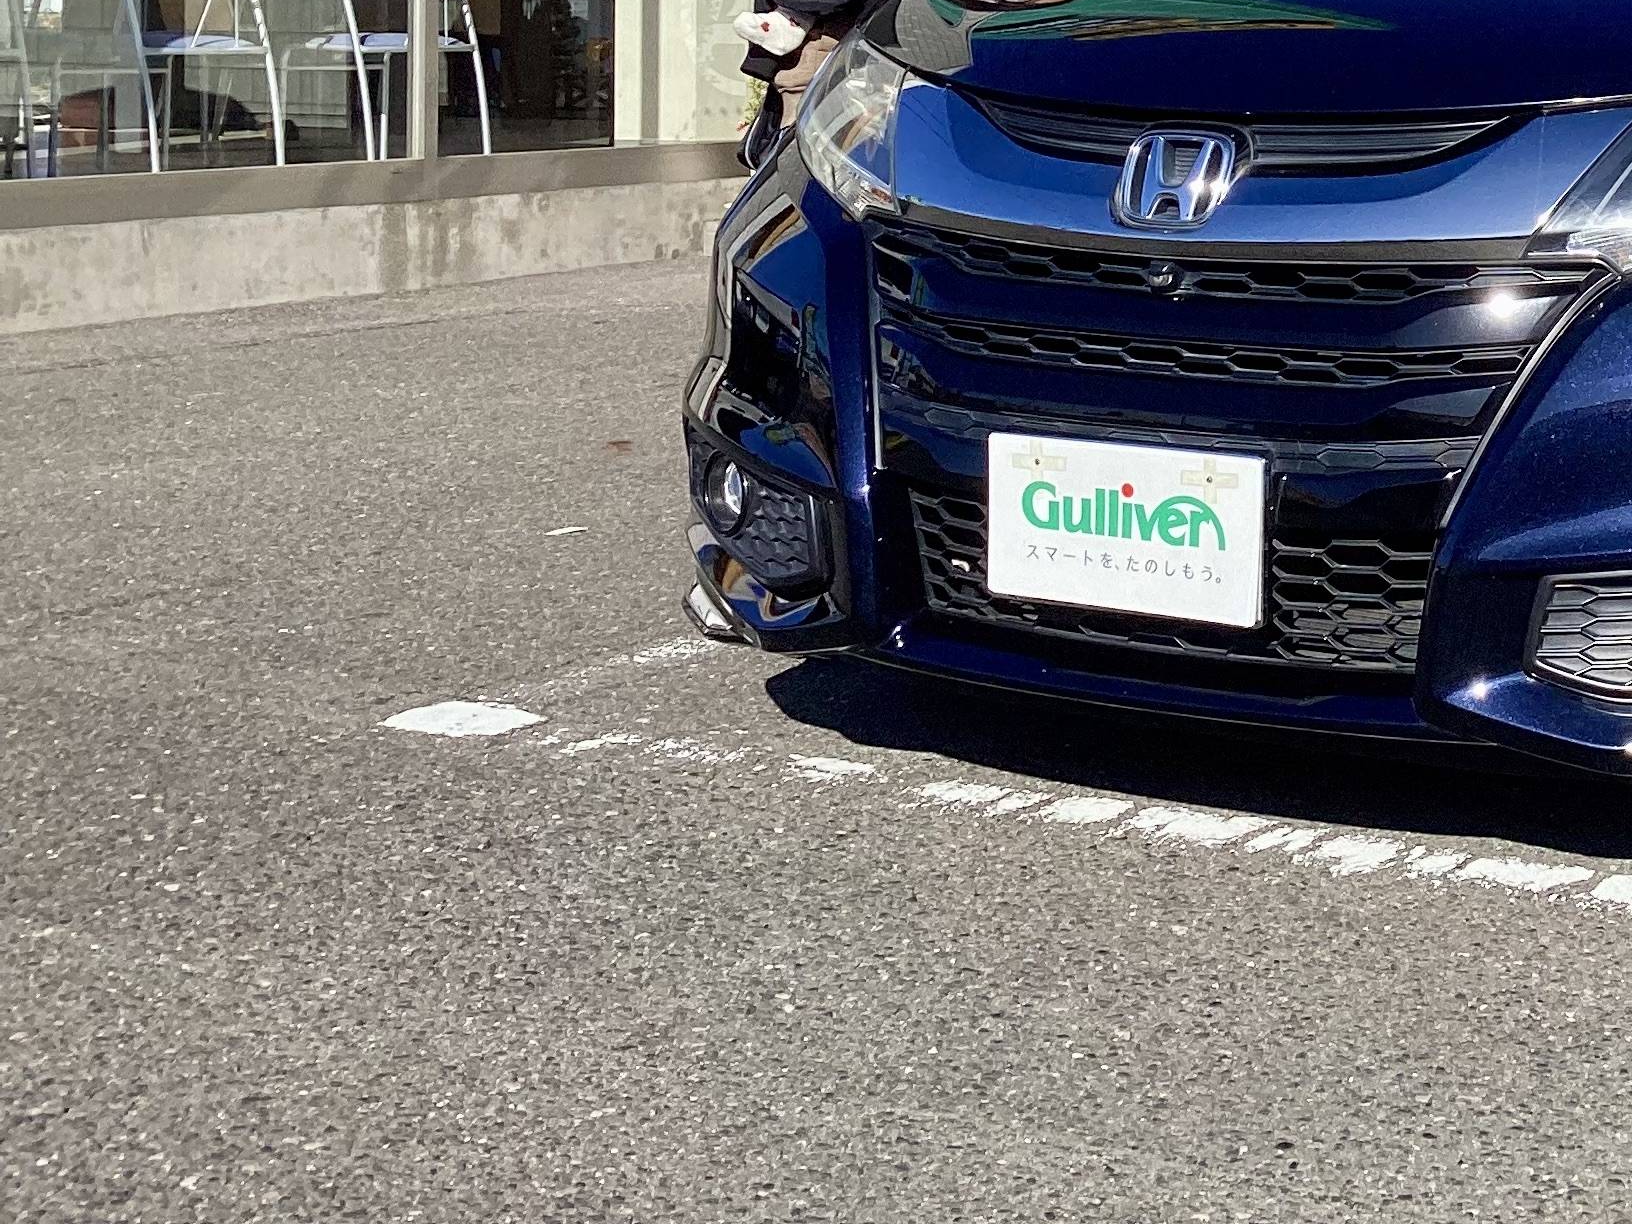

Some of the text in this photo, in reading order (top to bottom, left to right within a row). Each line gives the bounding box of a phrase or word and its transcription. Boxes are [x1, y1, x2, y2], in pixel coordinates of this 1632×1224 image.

[1021, 480, 1227, 551] Gulliver
[1026, 543, 1224, 585] スマートを、たのしもう。
